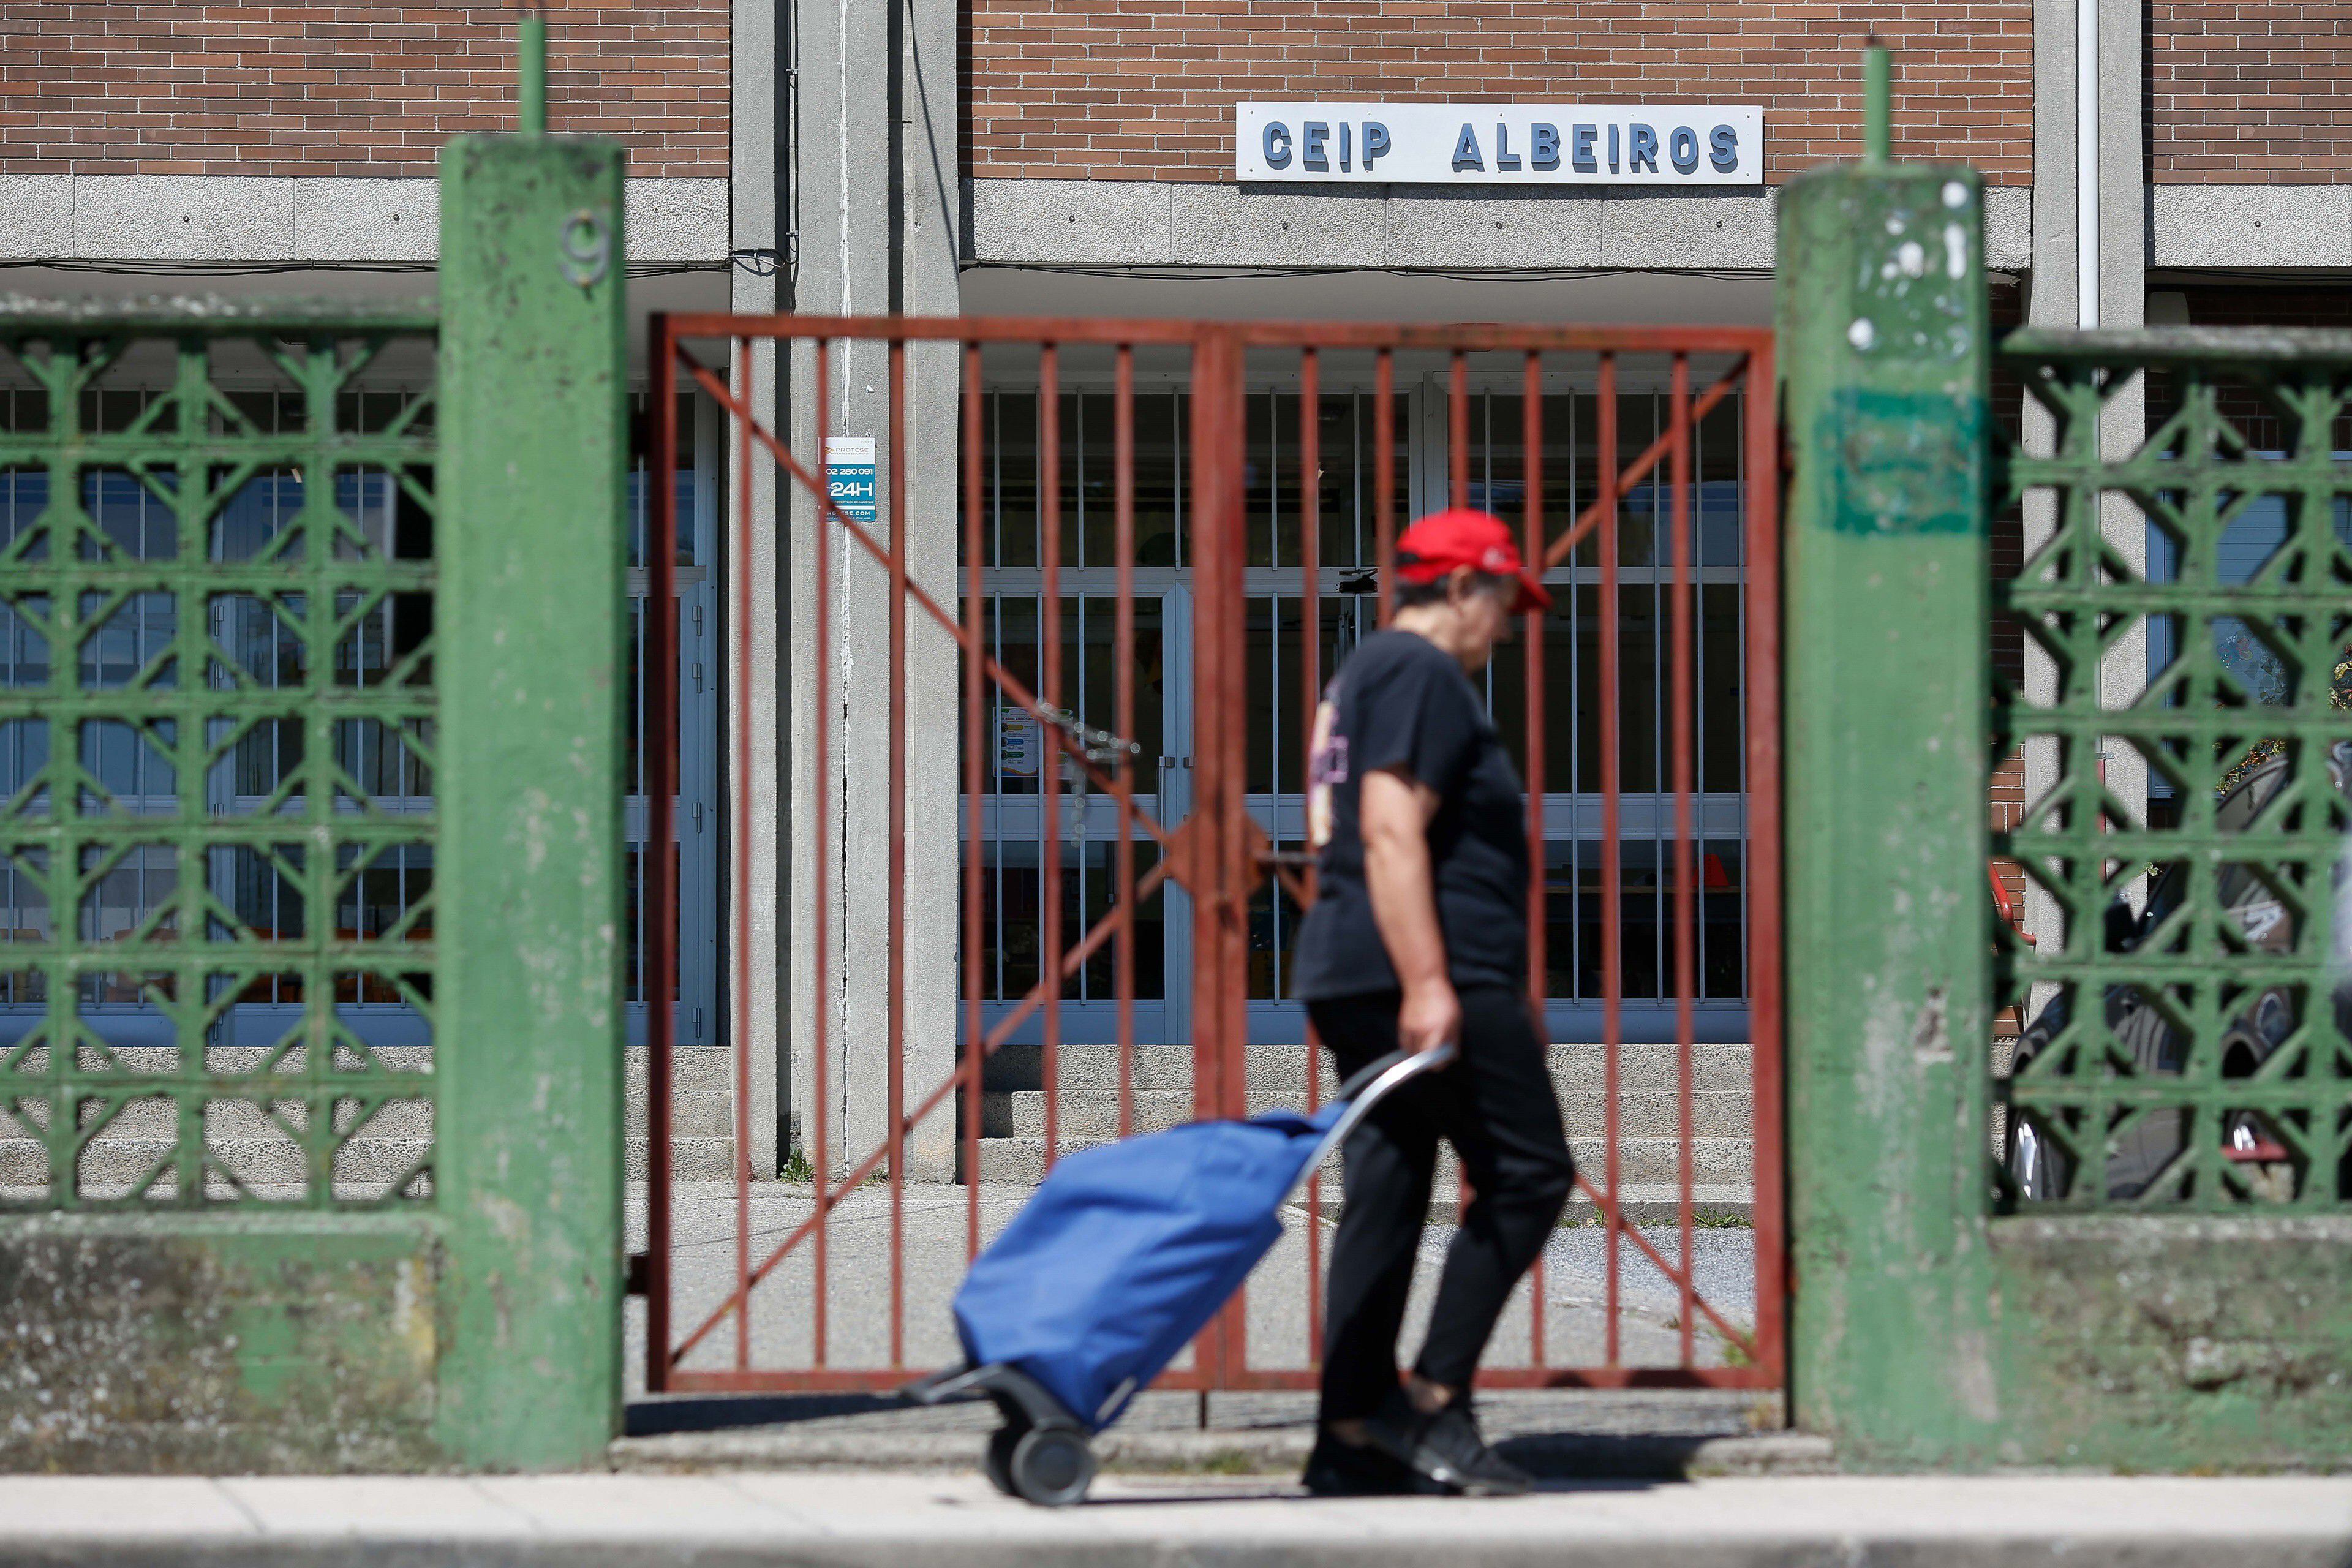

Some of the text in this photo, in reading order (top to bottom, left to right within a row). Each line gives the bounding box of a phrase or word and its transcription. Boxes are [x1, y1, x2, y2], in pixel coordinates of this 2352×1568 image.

[1262, 121, 1740, 174] CEIP ALBEIROS
[560, 209, 611, 287] 9
[830, 481, 873, 497] 24H
